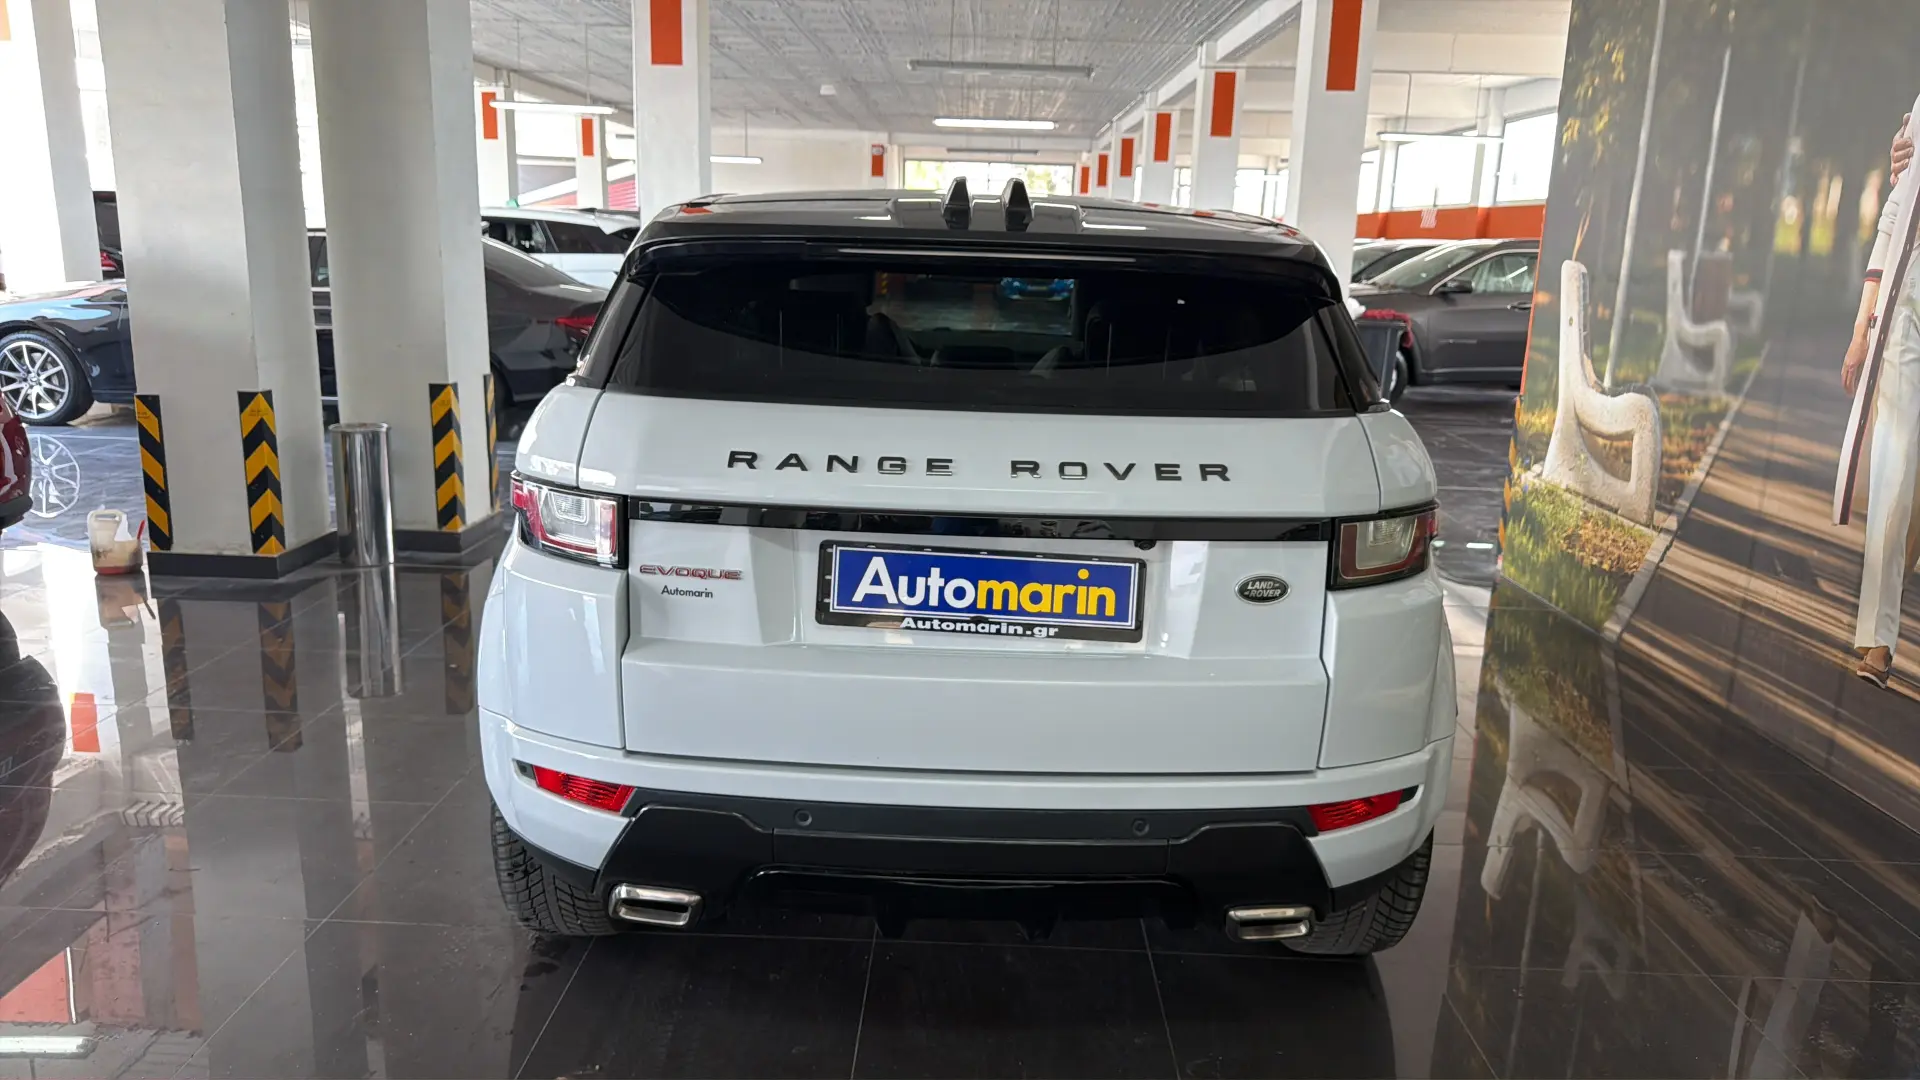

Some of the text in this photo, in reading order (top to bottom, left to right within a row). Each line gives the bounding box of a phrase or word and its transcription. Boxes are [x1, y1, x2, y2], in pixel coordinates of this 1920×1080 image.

[727, 450, 1231, 482] RANGE ROVER
[639, 564, 744, 581] EVOQUE
[660, 585, 714, 599] Automarin
[851, 556, 1116, 617] Automarin
[899, 616, 1060, 638] Automarin.gr
